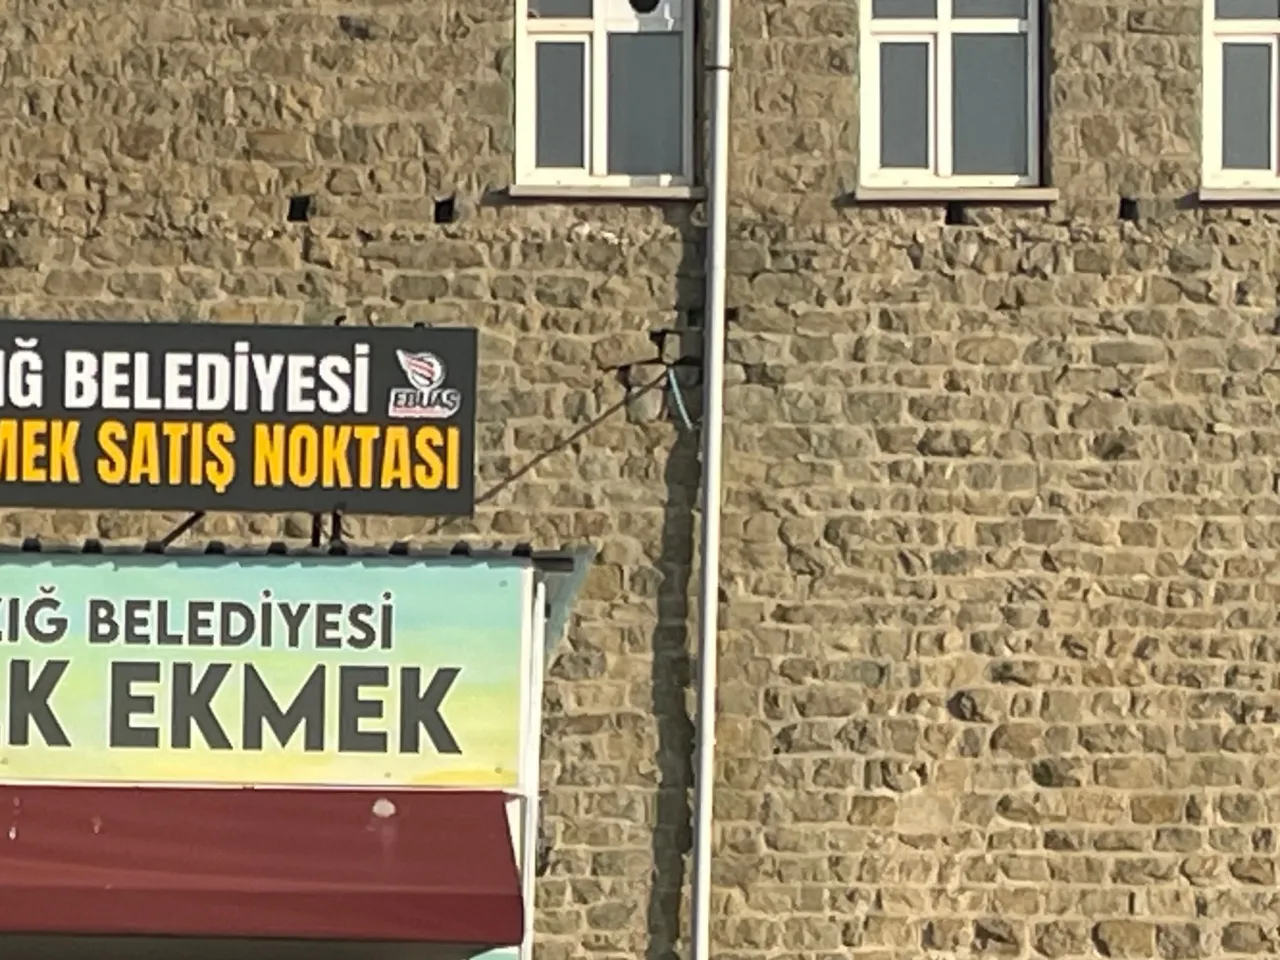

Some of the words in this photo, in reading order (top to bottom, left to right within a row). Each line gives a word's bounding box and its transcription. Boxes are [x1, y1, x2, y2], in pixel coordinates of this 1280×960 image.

[64, 341, 370, 413] BELEDİYESİ
[97, 420, 236, 493] SATIŞ
[253, 422, 460, 490] NOKTASI
[88, 589, 393, 650] BELEDİYESİ
[109, 660, 463, 755] EKMEK
